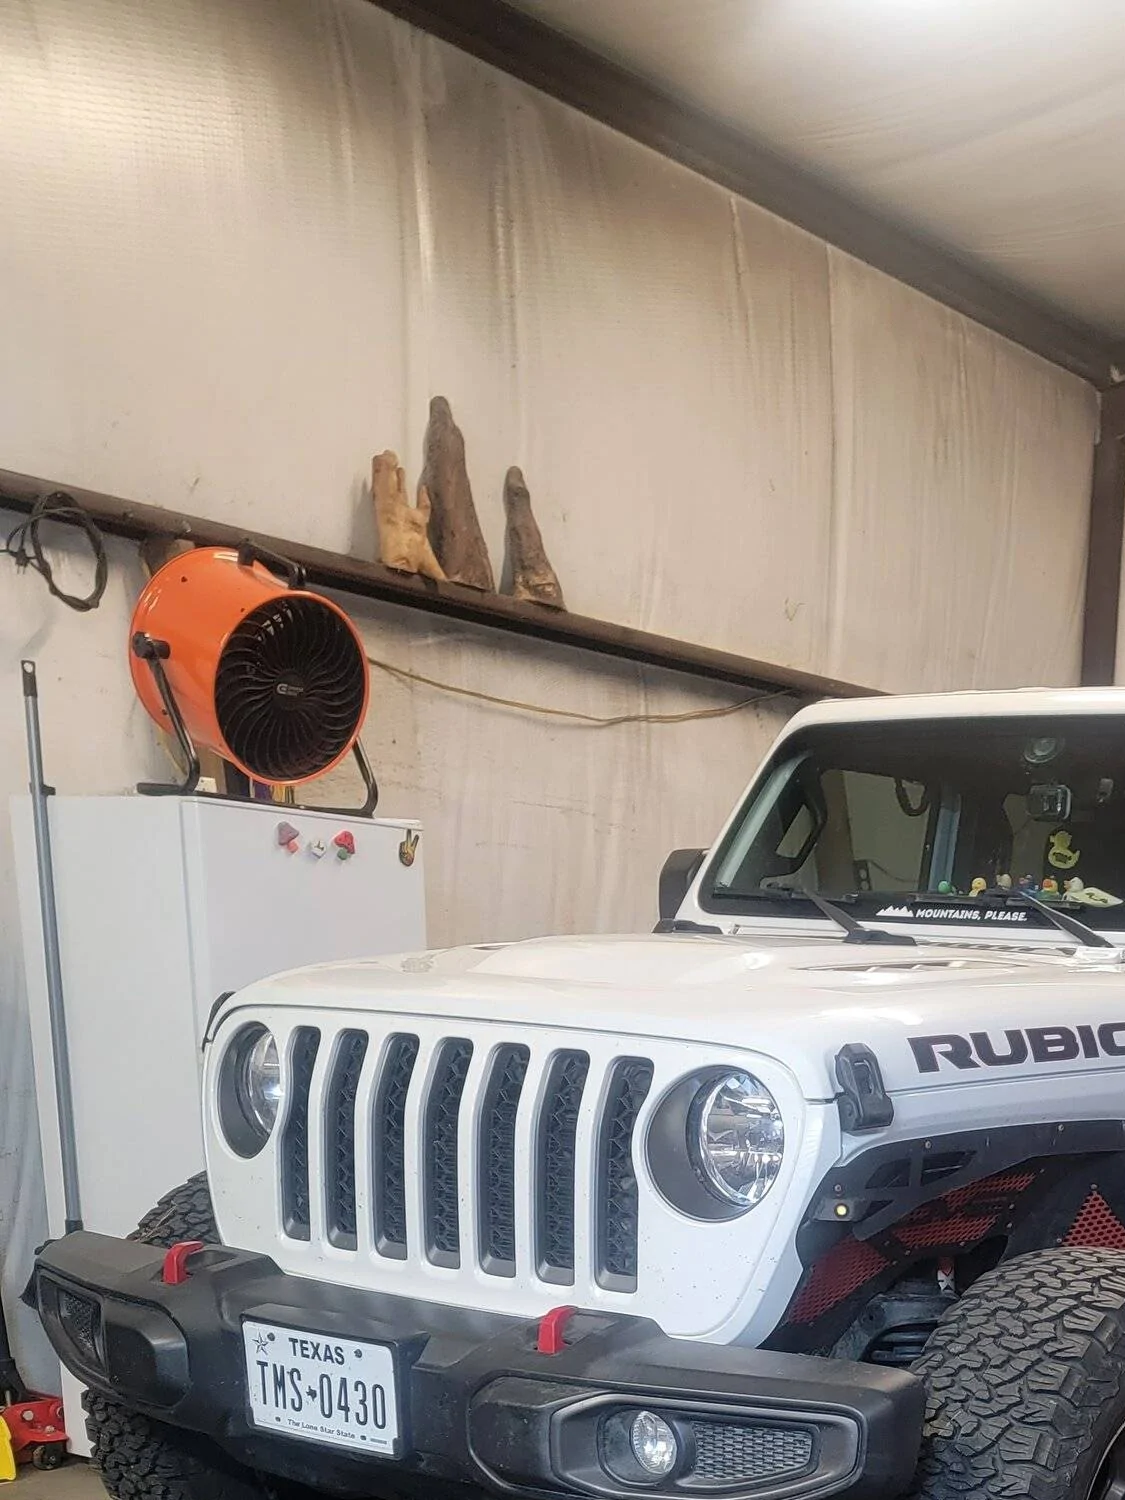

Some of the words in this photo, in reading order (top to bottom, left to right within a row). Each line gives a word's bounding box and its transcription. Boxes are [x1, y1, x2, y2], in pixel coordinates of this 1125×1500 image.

[915, 908, 981, 921] MOUNTAINS,
[984, 910, 1027, 922] PLEASE.
[288, 1337, 345, 1365] TEXAS
[287, 1418, 301, 1428] The
[301, 1422, 318, 1431] Lone
[320, 1426, 335, 1436] Star
[336, 1429, 355, 1440] State
